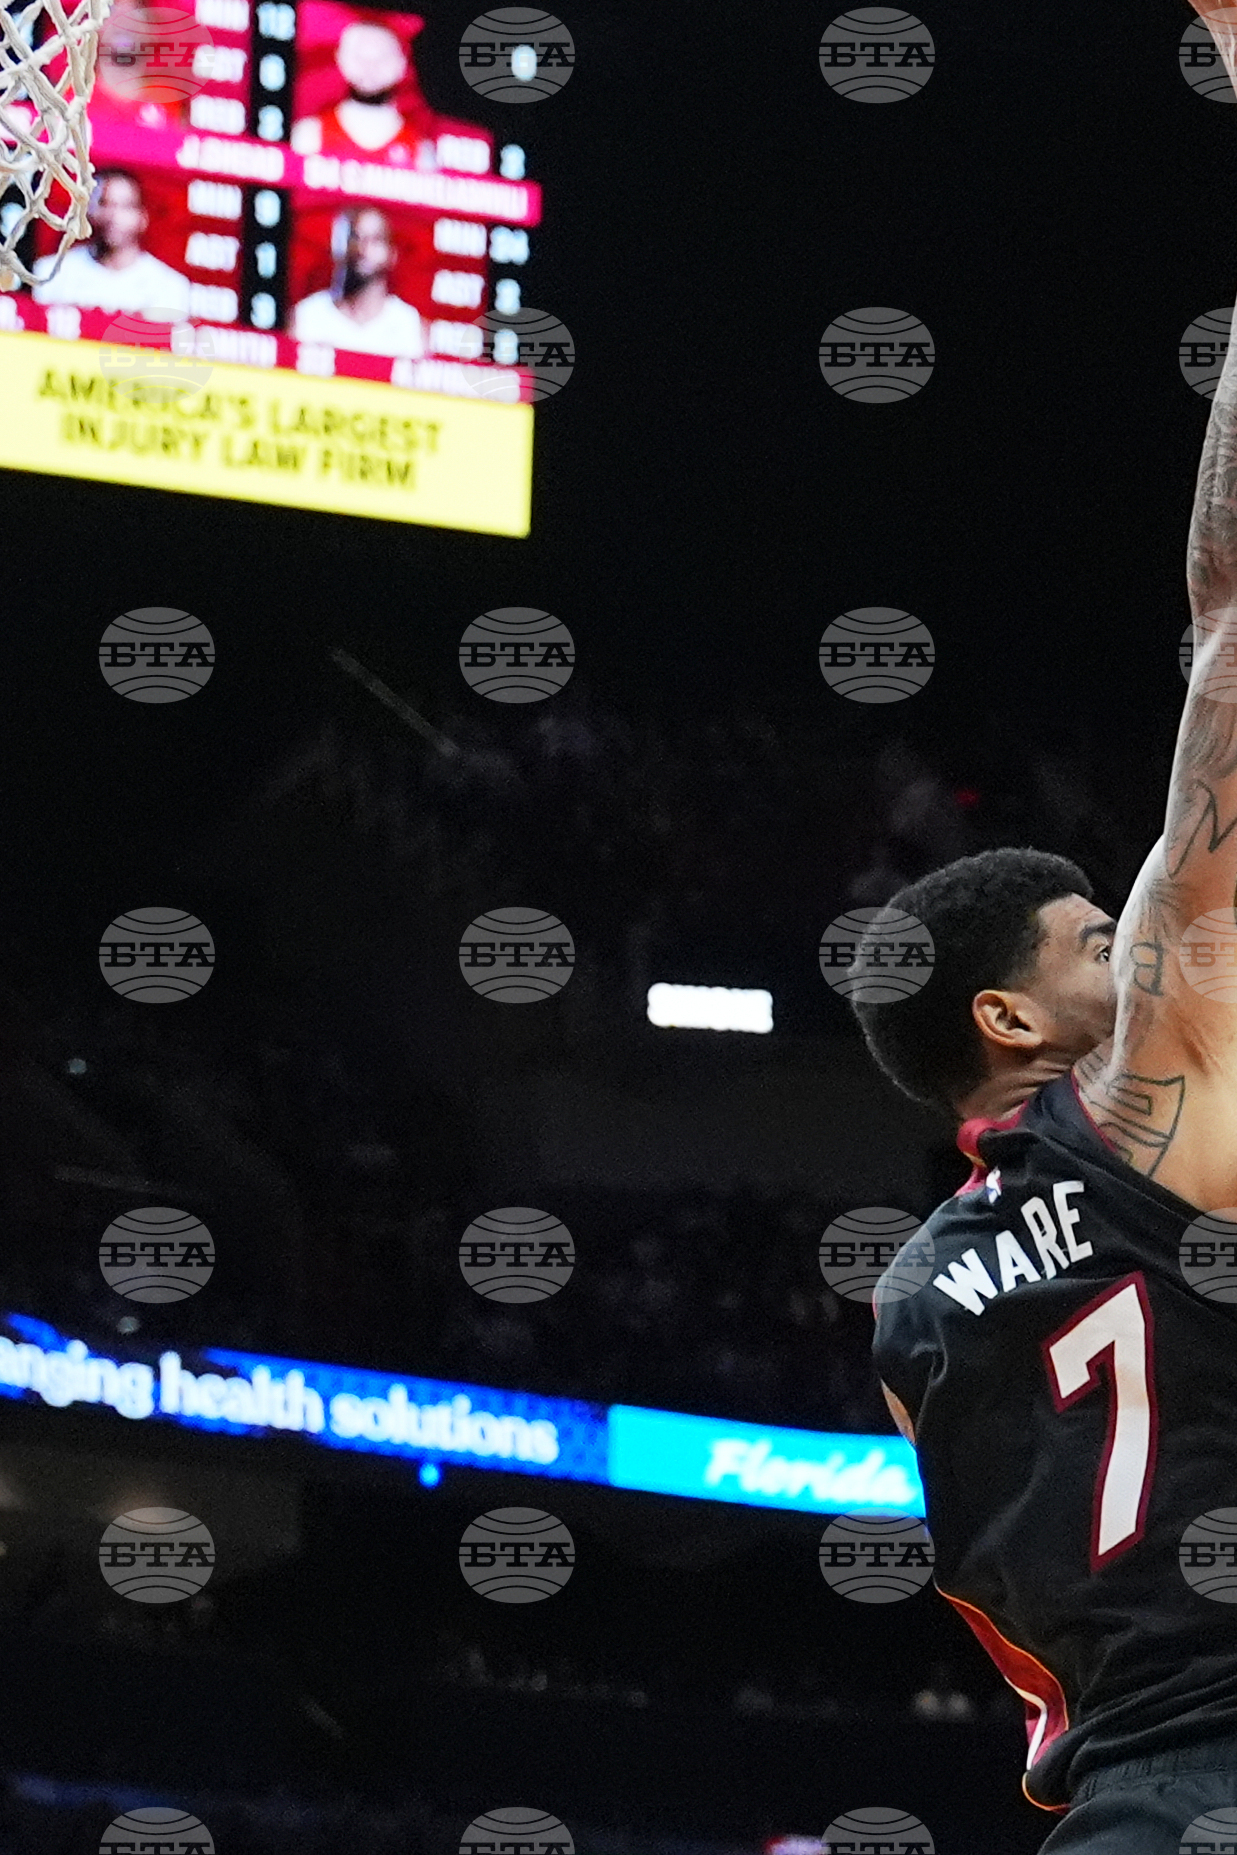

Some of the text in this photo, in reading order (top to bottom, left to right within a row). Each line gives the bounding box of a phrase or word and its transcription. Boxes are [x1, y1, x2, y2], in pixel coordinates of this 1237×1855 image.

[36, 368, 446, 456] AMERICA'S LARGEST
[63, 411, 418, 489] INJURY LAW FIRM
[932, 1180, 1094, 1316] WARE
[159, 1351, 325, 1434] health
[329, 1383, 560, 1465] solutions
[1043, 1270, 1156, 1572] 7
[704, 1438, 917, 1503] Florida
